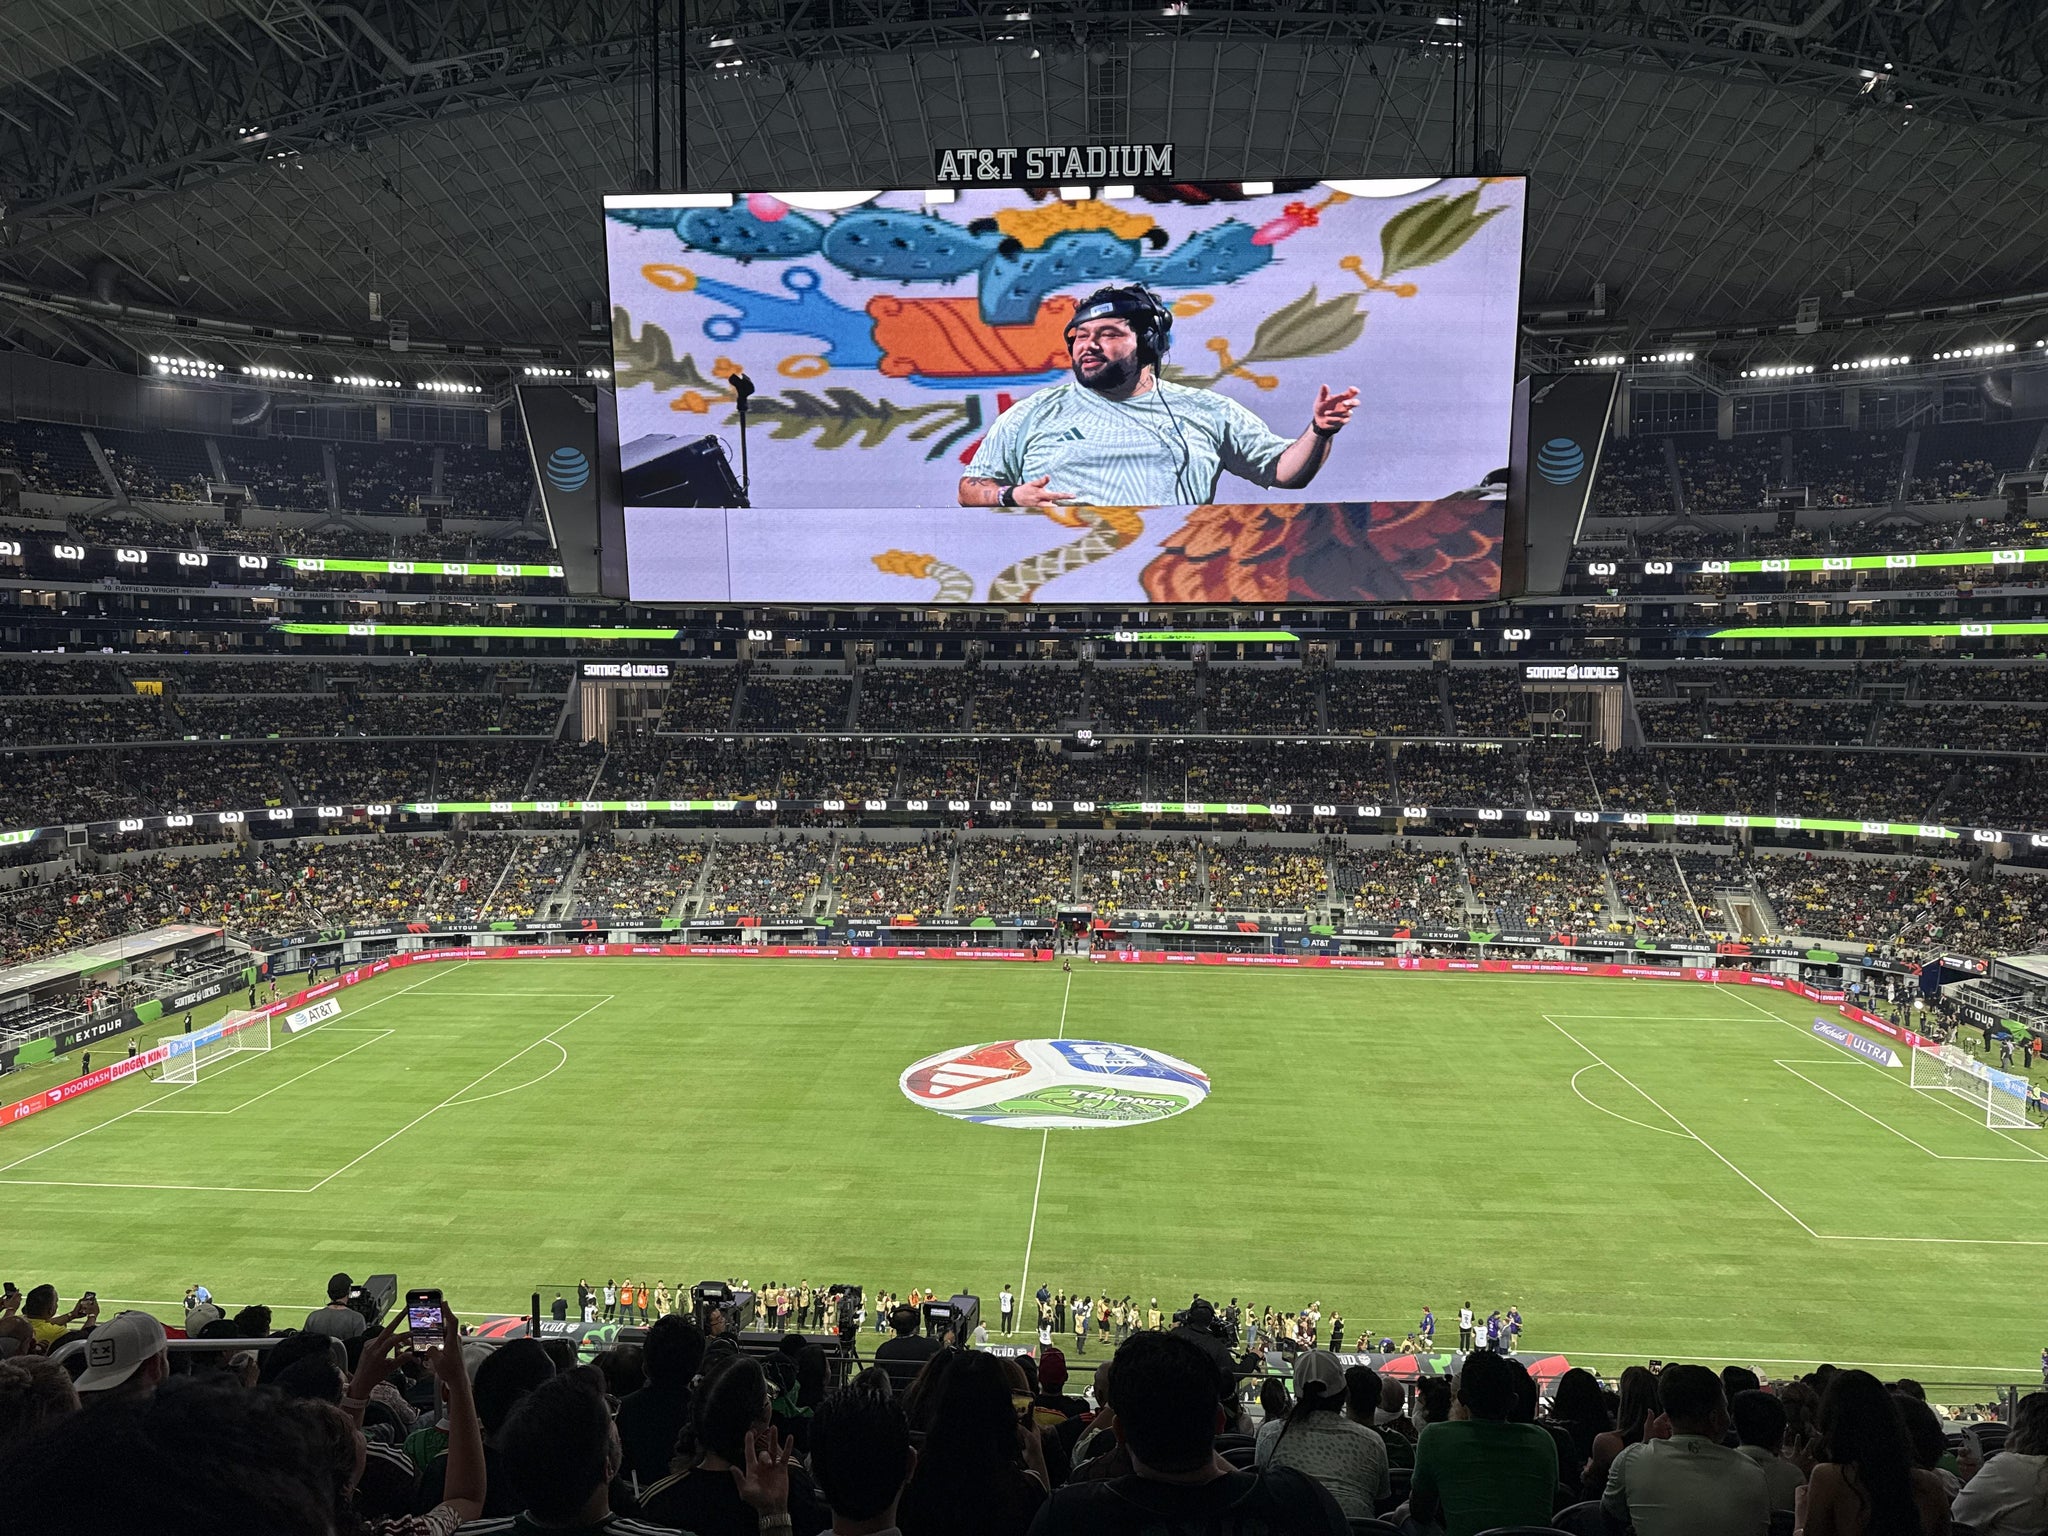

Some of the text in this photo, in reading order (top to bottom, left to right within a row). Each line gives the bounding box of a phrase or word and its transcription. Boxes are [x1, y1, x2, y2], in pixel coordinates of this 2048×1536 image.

[937, 144, 1173, 181] AT&T STADIUM
[115, 585, 150, 593] RAYFIELD
[632, 664, 669, 677] LOCALES
[1579, 666, 1619, 679] LOCALES
[1872, 959, 1892, 969] AT&T
[308, 1002, 333, 1022] AT&T
[64, 1018, 122, 1046] MEXTOUR
[1812, 1021, 1847, 1041] Michelob
[1853, 1038, 1888, 1062] ULTRA
[112, 1047, 168, 1077] BURGER KING
[64, 1071, 110, 1096] DOORDASH
[1069, 1089, 1176, 1107] TRIONDA
[14, 1103, 30, 1119] ria
